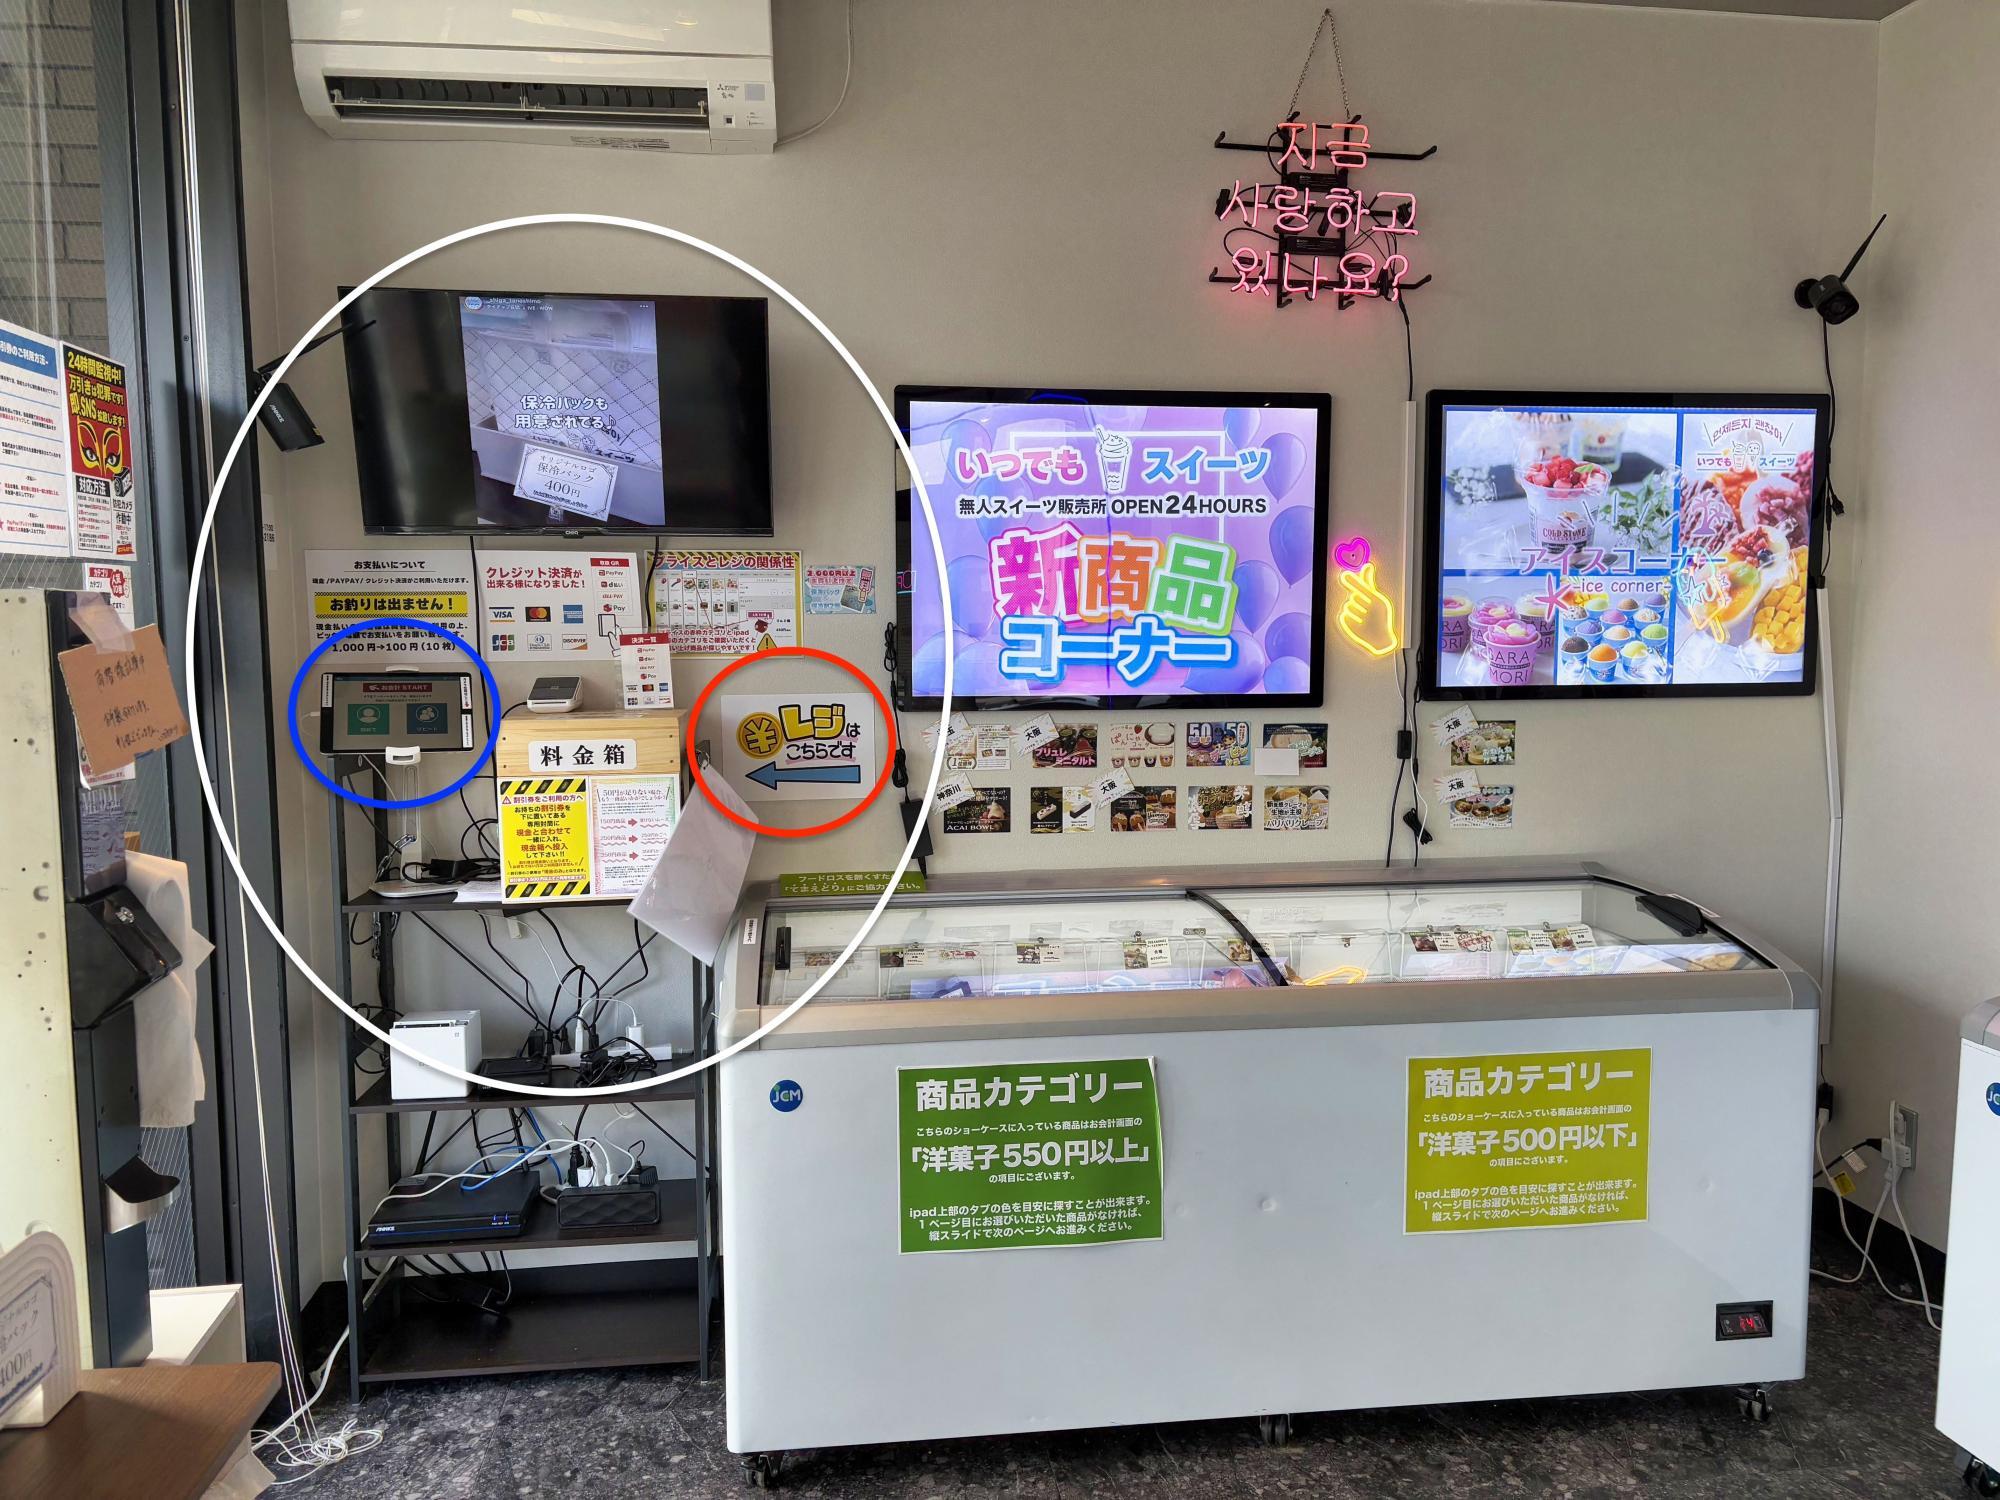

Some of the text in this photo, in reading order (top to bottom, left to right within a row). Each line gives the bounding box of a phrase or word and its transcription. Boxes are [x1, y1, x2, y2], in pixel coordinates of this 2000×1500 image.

[1277, 122, 1371, 170] 지금
[1219, 180, 1419, 235] 사랑하고
[1231, 247, 1408, 302] 있나요?
[68, 351, 121, 384] 24時間監視中!
[69, 373, 124, 405] 万引きは犯罪です!
[1712, 418, 1783, 442] 언제든지 괜찮아
[957, 447, 1270, 484] いつでも スイーツ
[1697, 457, 1795, 467] いつでも スイーツ
[538, 462, 594, 483] 保冷パック
[78, 478, 107, 496] 対応方法
[544, 480, 581, 498] 400円
[958, 498, 1106, 515] 無人スイーツ販売所
[1543, 527, 1586, 538] COLD STONE
[354, 560, 426, 570] お支払いについて
[486, 566, 583, 580] クレジット決済が
[991, 528, 1234, 629] 新商品
[493, 610, 513, 619] VISA
[1001, 616, 1233, 682] コーナー
[778, 703, 861, 743] レジは
[1445, 718, 1462, 733] 大阪
[1025, 726, 1041, 741] 大阪
[540, 744, 625, 767] 料金箱
[786, 741, 857, 760] こちらです
[936, 783, 962, 801] 神奈川
[1100, 781, 1117, 794] 大阪
[1448, 780, 1465, 792] 大阪
[513, 794, 584, 804] 割引券をご利用の方へ
[515, 804, 571, 813] お持ちの割引券を
[520, 812, 566, 820] 下に置いてある
[516, 827, 571, 837] 現金と合わせて
[521, 842, 569, 852] 現金箱へ投入
[798, 873, 900, 883] フードロスを無くすた
[1424, 1062, 1634, 1099] 商品カテゴリー
[772, 1085, 801, 1103] JCM
[916, 1072, 1143, 1112] 商品カテゴリー
[1422, 1104, 1632, 1123] こちらのショーケースに入っている商品はお会計画面の
[916, 1117, 1142, 1137] こちらのショーケースに入っている商品はお会計画面の
[1418, 1123, 1638, 1157] 「洋菓子500円以下」
[912, 1137, 1149, 1173] 「洋菓子550円以上」
[1489, 1155, 1570, 1168] の項目にございます。
[988, 1171, 1076, 1184] の項目にございます。
